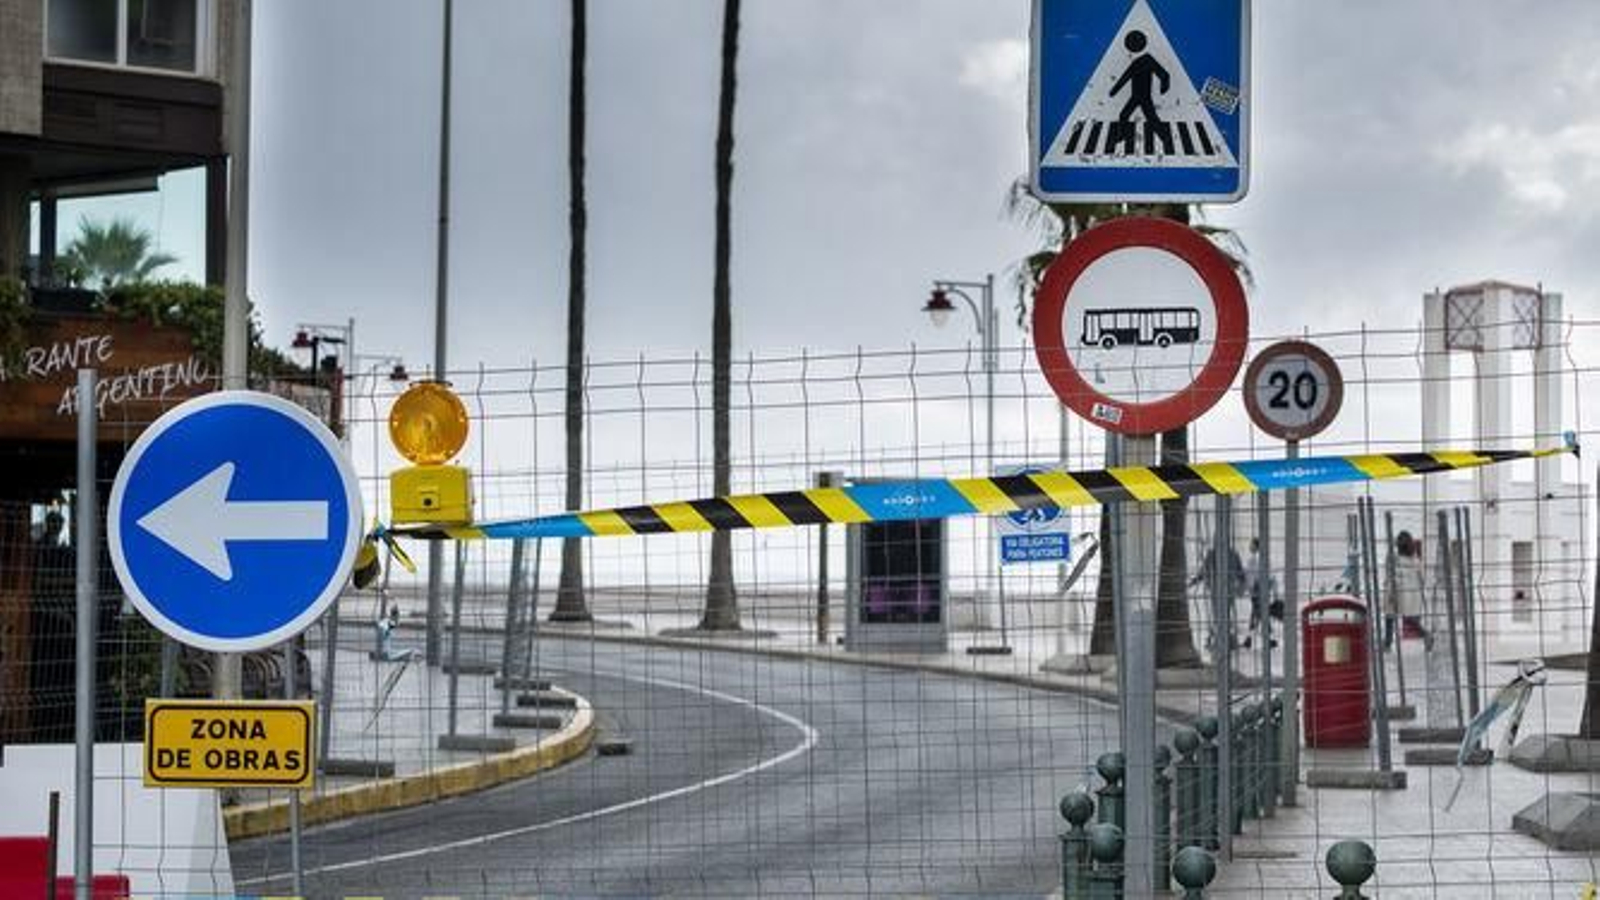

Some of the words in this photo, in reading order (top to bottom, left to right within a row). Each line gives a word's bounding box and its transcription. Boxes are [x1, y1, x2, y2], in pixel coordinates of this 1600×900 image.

[0, 335, 114, 381] RANTE
[1268, 370, 1318, 410] 20
[191, 718, 267, 740] ZONA
[157, 748, 191, 769] DE
[205, 749, 301, 770] OBRAS
